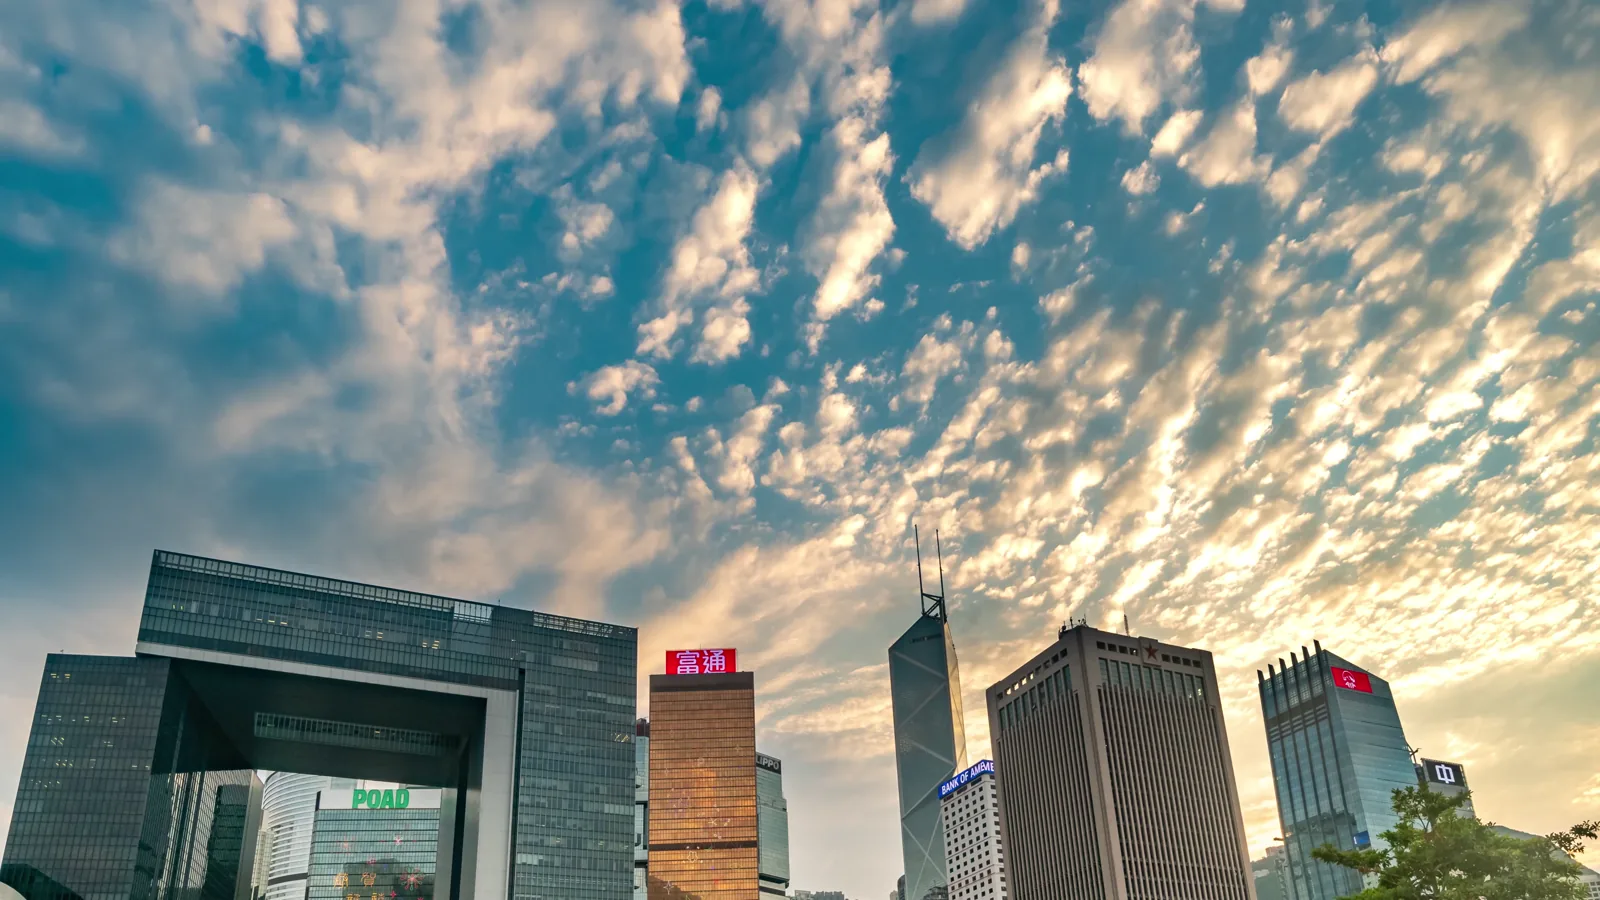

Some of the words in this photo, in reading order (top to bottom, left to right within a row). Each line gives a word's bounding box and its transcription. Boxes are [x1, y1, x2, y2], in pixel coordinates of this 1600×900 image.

[676, 650, 727, 675] 富通
[756, 755, 779, 770] LIPPO
[941, 777, 959, 795] BANK
[960, 770, 969, 783] OF
[352, 789, 409, 809] POAD
